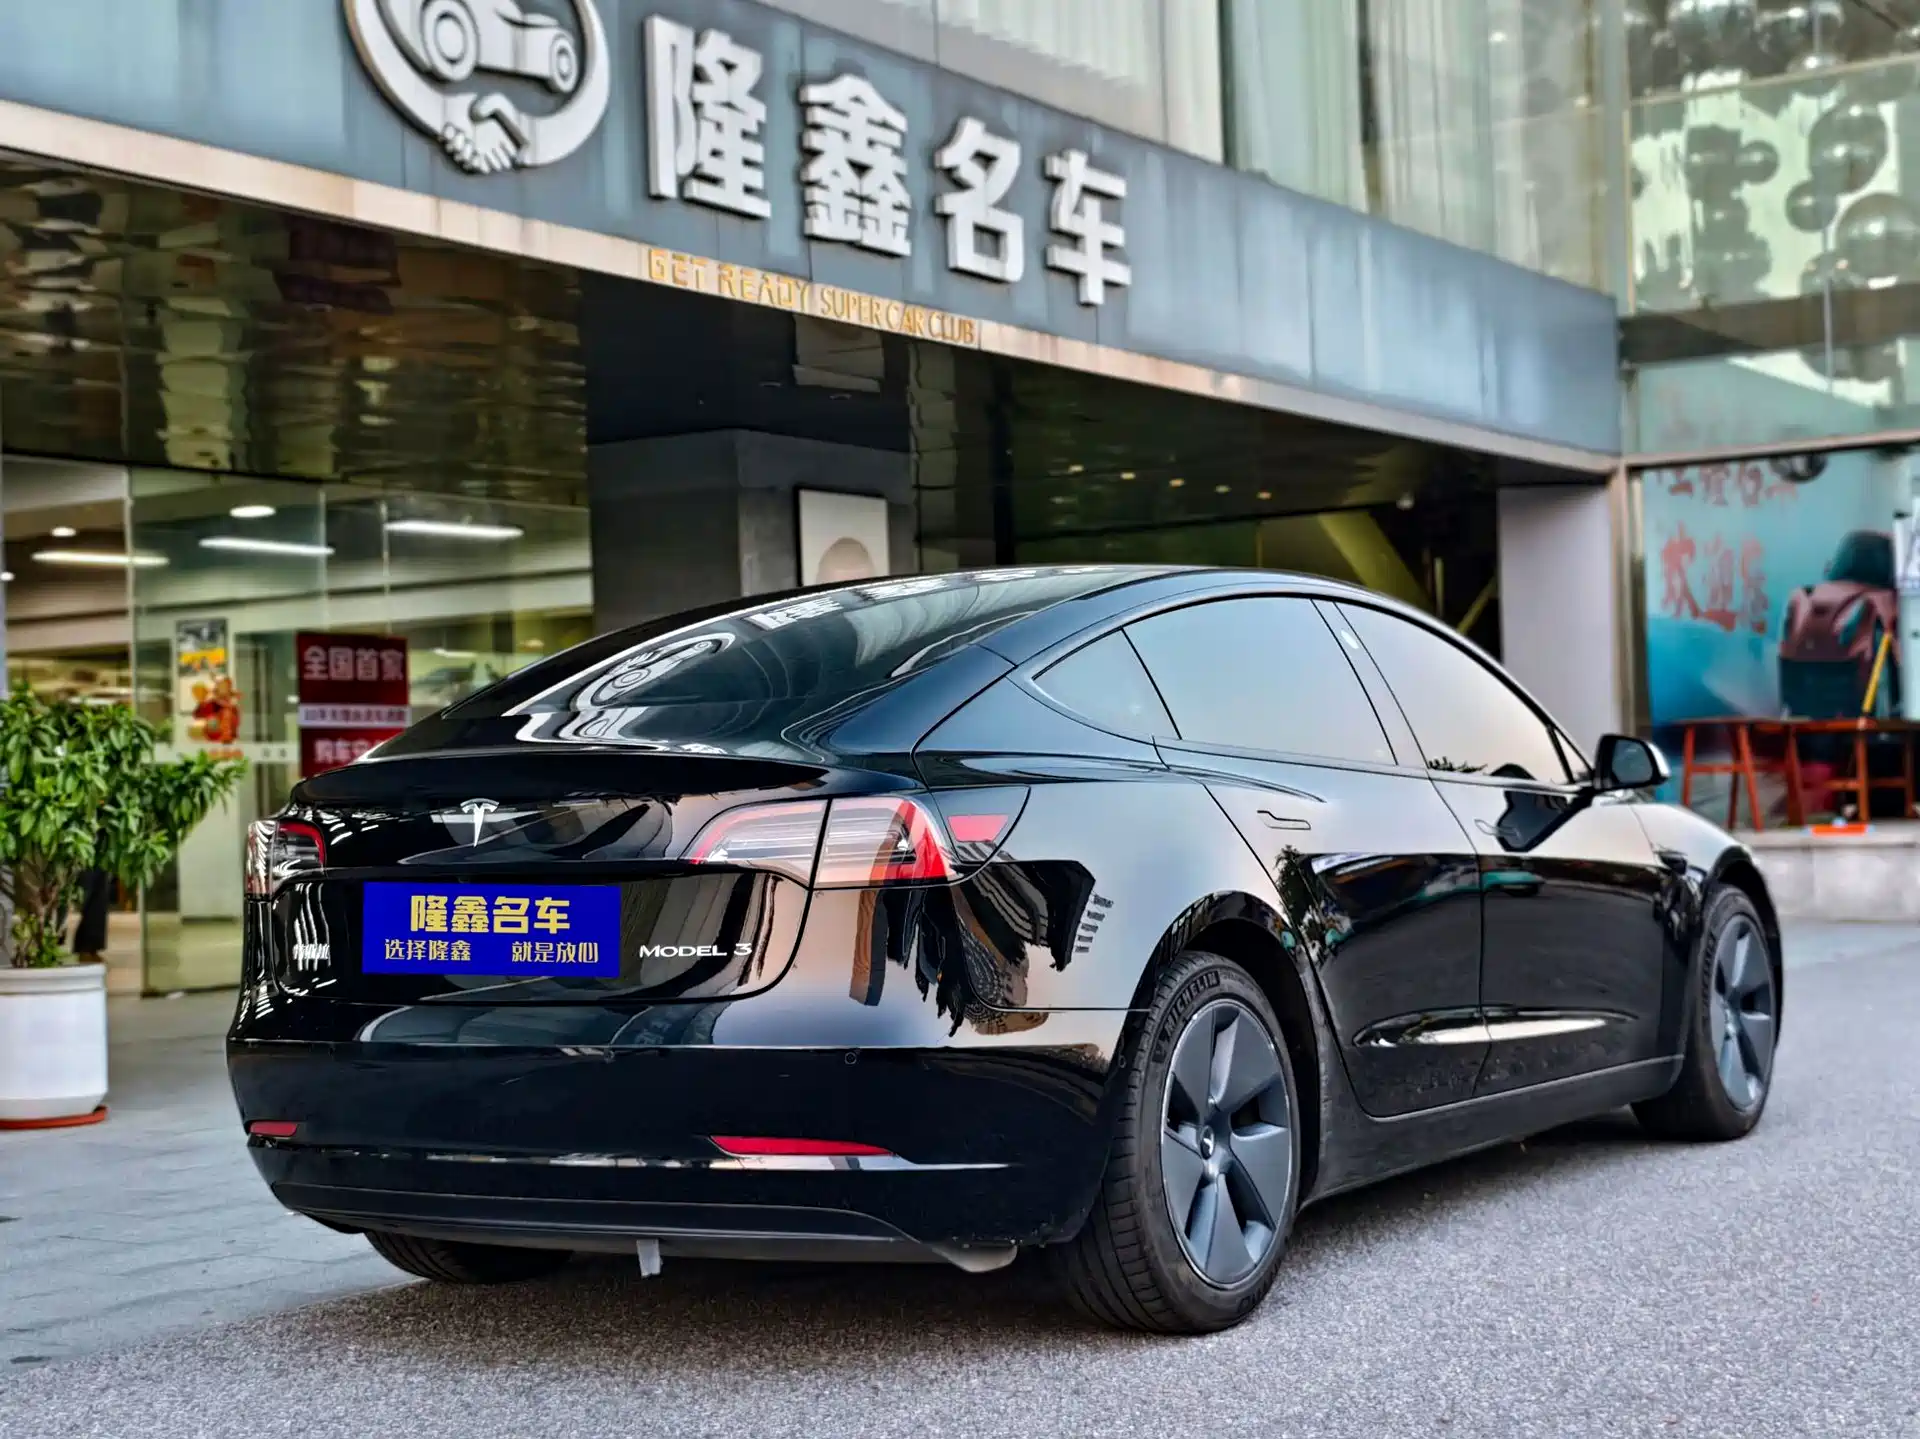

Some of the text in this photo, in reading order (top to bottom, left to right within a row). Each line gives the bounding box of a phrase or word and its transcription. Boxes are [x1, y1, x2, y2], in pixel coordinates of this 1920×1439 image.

[645, 14, 1132, 306] 隆鑫名车
[648, 248, 975, 344] GET READY SUPER CAR CLUB
[303, 645, 404, 682] 全国首家
[410, 894, 571, 935] 隆鑫名车
[385, 938, 600, 964] 选择隆鑫 就是放心
[639, 942, 753, 958] MODEL 3
[1163, 970, 1220, 1038] MICHELIN
